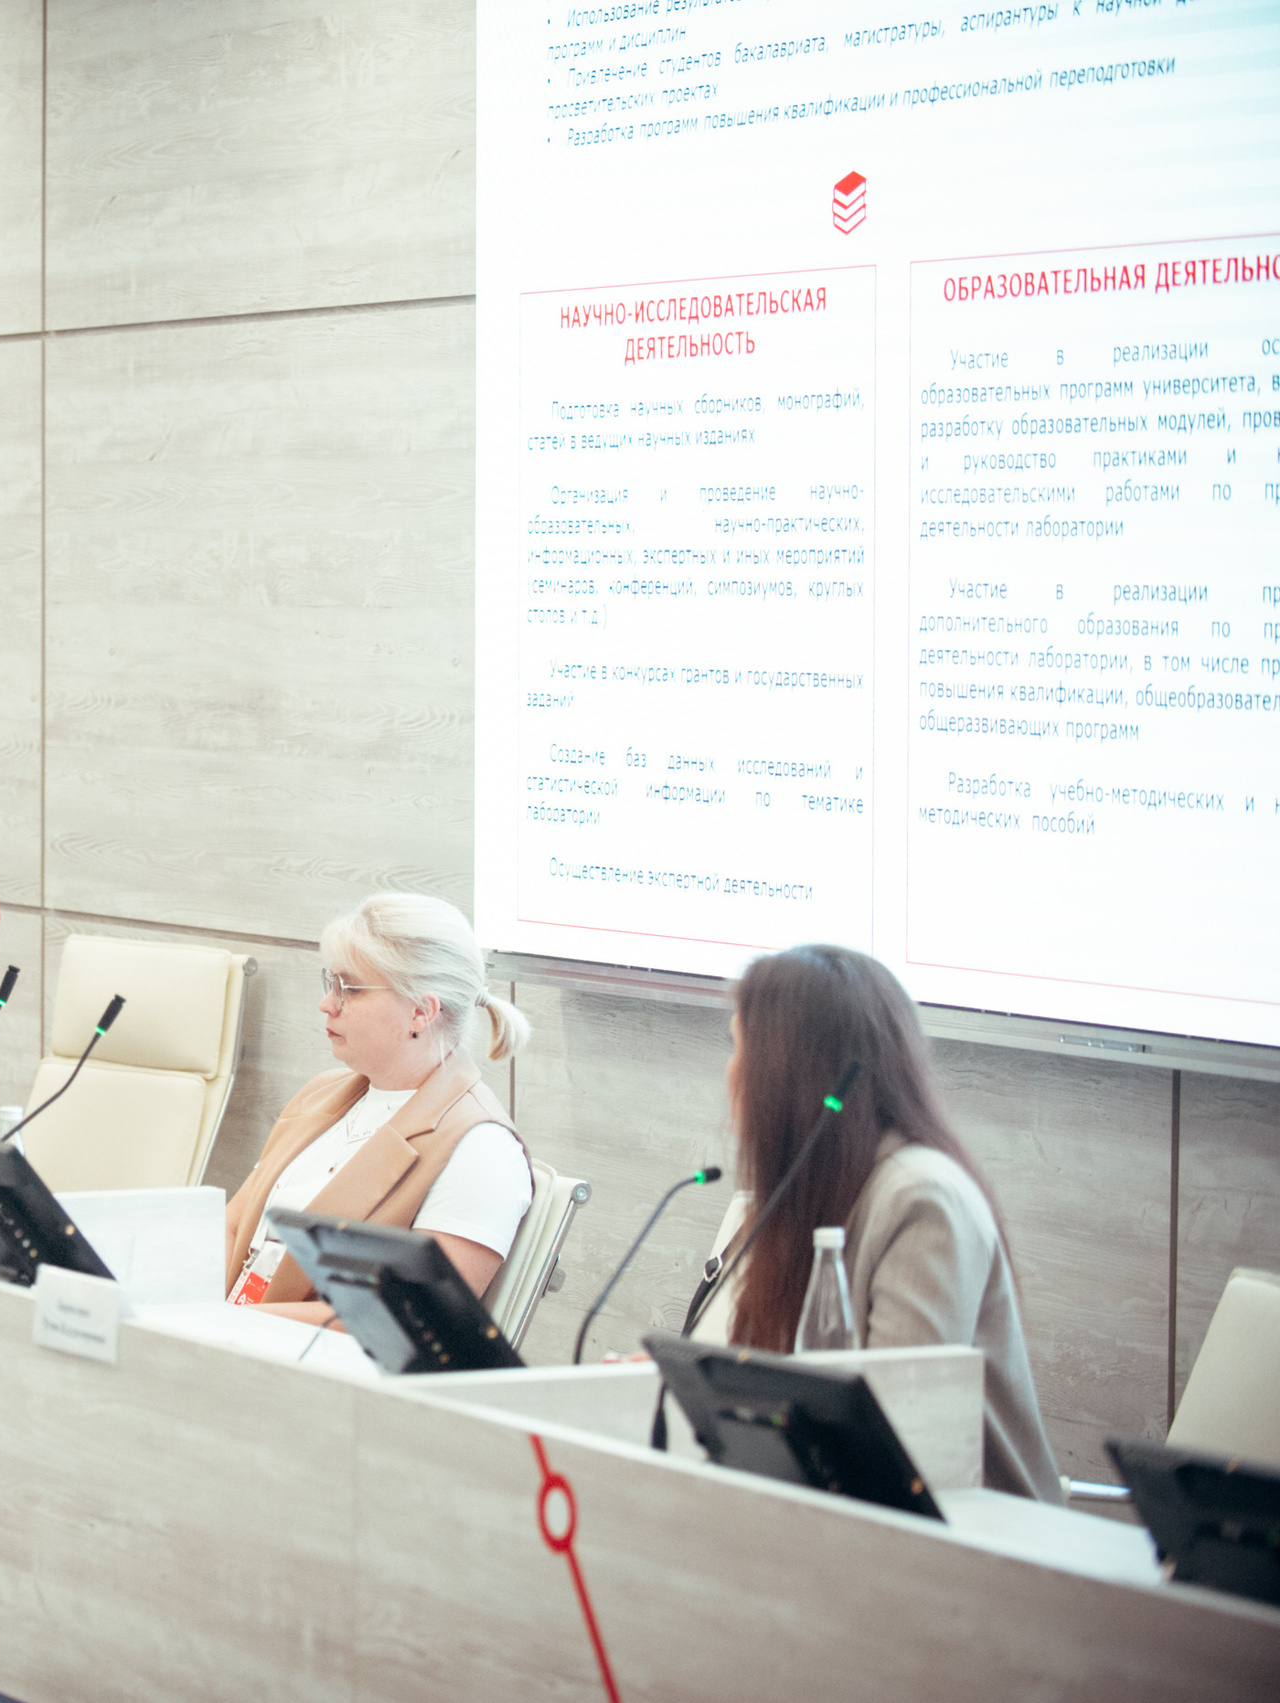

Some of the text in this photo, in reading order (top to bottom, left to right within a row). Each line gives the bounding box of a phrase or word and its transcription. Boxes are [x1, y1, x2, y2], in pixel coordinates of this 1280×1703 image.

[567, 0, 659, 28] Использование
[548, 25, 686, 61] программ и дисциплин
[567, 59, 648, 89] Привлечение
[659, 49, 721, 76] студентов
[734, 34, 829, 65] бакалавриата,
[844, 17, 946, 49] магистратуры,
[961, 2, 1058, 33] аспирантуры
[1072, 0, 1081, 16] к
[547, 80, 718, 122] просветительских проектах
[567, 56, 1176, 147] Разработка программ повышения квалификации и профессиональной переподготовки
[943, 263, 1146, 301] ОБРАЗОВАТЕЛЬНАЯ
[560, 287, 827, 329] НАУЧНО-ИССЛЕДОВАТЕЛЬСКАЯ
[625, 331, 756, 366] ДЕЯТЕЛЬНОСТЬ
[950, 349, 1009, 371] Участие
[1057, 349, 1064, 365] в
[1113, 340, 1209, 368] реализации
[551, 388, 865, 421] Подготовка научных сборников, монографий,
[921, 382, 1050, 409] образовательных
[1060, 378, 1133, 405] программ
[1143, 373, 1261, 400] университета,
[921, 416, 1003, 442] разработку
[1012, 412, 1147, 441] образовательных
[1158, 407, 1232, 434] модулей,
[527, 427, 756, 454] статей в ведущих научных изданиях
[921, 447, 1236, 473] и руководство практиками и
[551, 482, 864, 507] Организация и проведение научно-
[921, 485, 1076, 507] исследовательскими
[1105, 479, 1180, 506] работами
[1212, 482, 1232, 500] по
[527, 514, 865, 537] образовательных, научно-практических,
[920, 514, 1124, 541] деятельности лаборатории
[527, 542, 865, 569] информационных, экспертных и иных мероприятий
[609, 574, 697, 599] конференций,
[708, 580, 798, 599] симпозиумов,
[809, 579, 863, 599] круглых
[949, 577, 1008, 601] Участие
[1056, 584, 1064, 600] в
[1113, 583, 1208, 605] реализации
[527, 607, 565, 625] столов
[570, 609, 577, 625] и
[919, 614, 1048, 636] дополнительного
[1077, 612, 1179, 639] образования
[1211, 621, 1231, 637] по
[550, 659, 863, 690] Участие в конкурсах грантов и государственных
[919, 647, 1019, 668] деятельности
[1028, 647, 1133, 673] лаборатории,
[1144, 656, 1152, 671] в
[1163, 655, 1190, 672] том
[1201, 656, 1249, 674] числе
[526, 690, 574, 710] заданий
[919, 681, 1004, 700] повышения
[1010, 681, 1128, 707] квалификации,
[919, 710, 1139, 744] общеразвивающих программ
[550, 743, 863, 781] Создание баз данных исследований и
[526, 775, 864, 814] статистической информации по тематике
[948, 771, 1031, 799] Разработка
[1050, 779, 1224, 811] учебно-методических
[1245, 797, 1254, 813] и
[525, 801, 601, 827] лаборатории
[919, 808, 1095, 835] методических пособий
[549, 857, 813, 901] Осуществление экспертной деятельности
